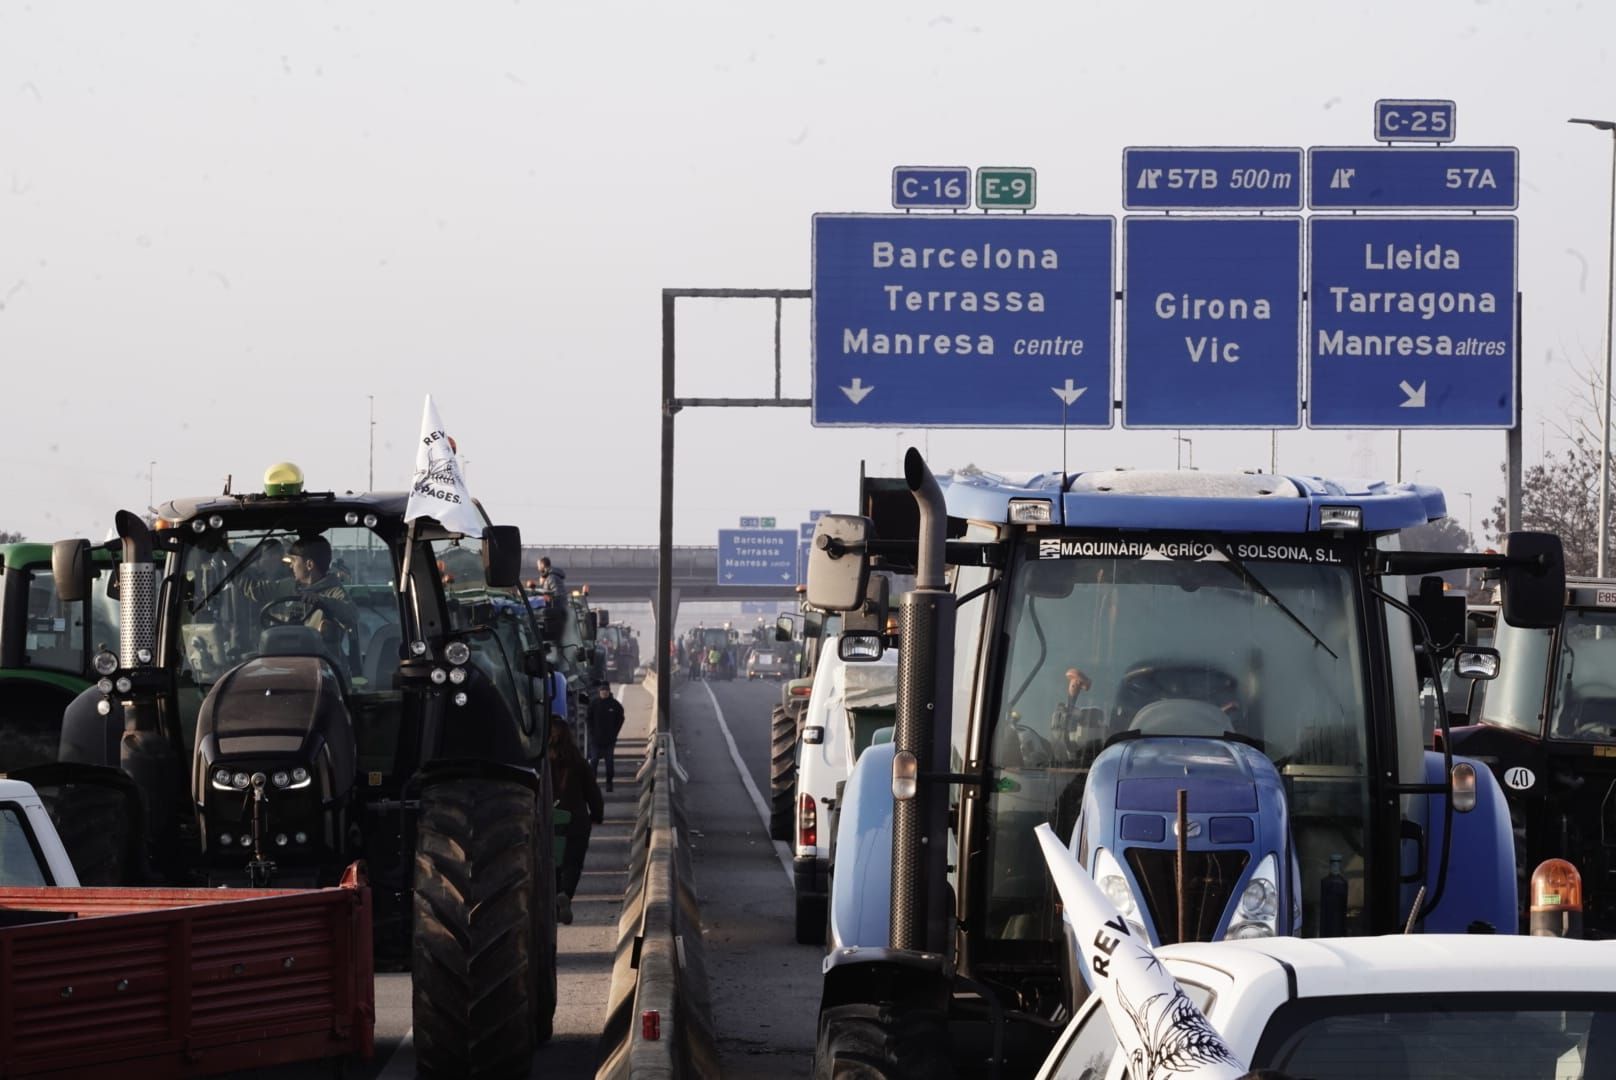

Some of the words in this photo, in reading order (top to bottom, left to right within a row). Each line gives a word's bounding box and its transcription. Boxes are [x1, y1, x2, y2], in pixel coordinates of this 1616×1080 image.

[1385, 111, 1447, 132] C-25
[902, 177, 962, 199] C-16
[985, 178, 1026, 199] E-9
[1167, 168, 1218, 189] 57B
[1446, 168, 1497, 189] 57A
[873, 241, 1058, 269] Barcelona
[1365, 243, 1460, 270] Lleida
[884, 285, 1045, 312] Terrassa
[1155, 292, 1271, 320] Girona
[1329, 286, 1496, 320] Tarragona
[843, 328, 994, 355] Manresa
[1013, 335, 1084, 356] centre
[1185, 336, 1240, 363] Vic
[1318, 330, 1453, 356] Manresa
[1455, 337, 1506, 356] altres
[733, 536, 784, 545] Barcelona
[736, 547, 780, 556] Terrassa
[1238, 544, 1312, 562] SOLSONA,
[1315, 548, 1342, 562] S.L.
[1512, 769, 1529, 787] 40
[1093, 915, 1131, 978] REV
